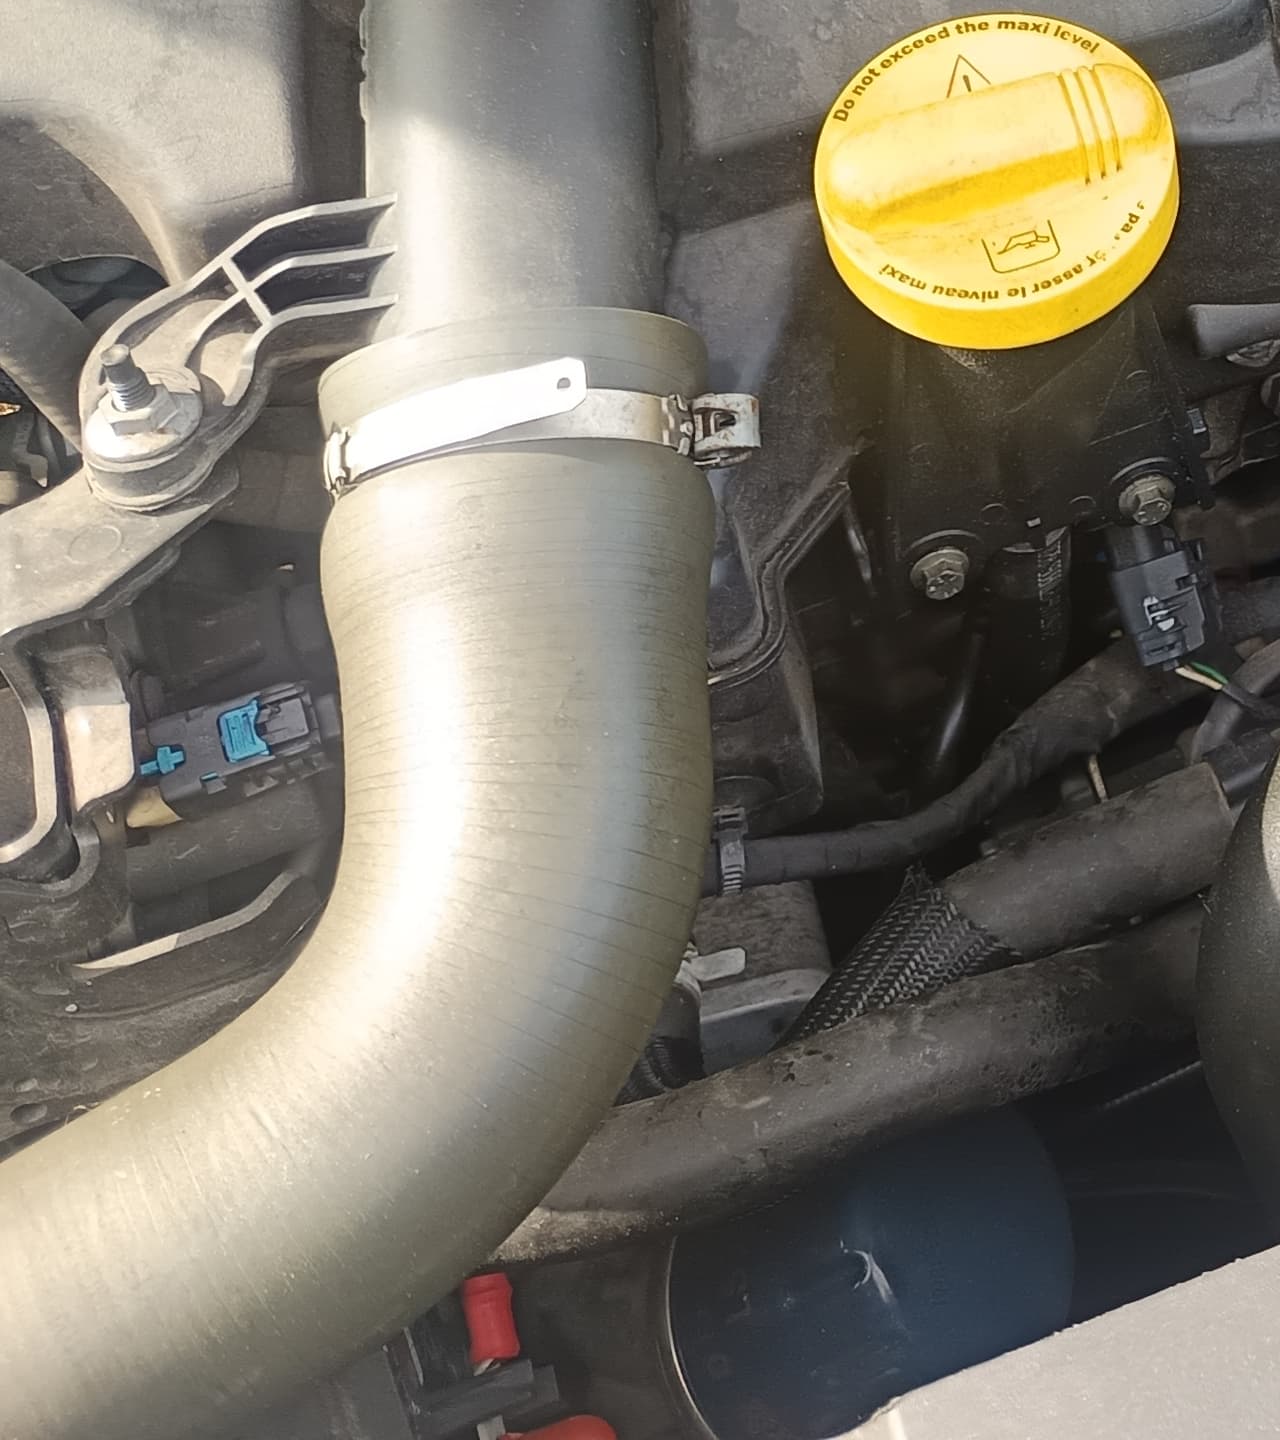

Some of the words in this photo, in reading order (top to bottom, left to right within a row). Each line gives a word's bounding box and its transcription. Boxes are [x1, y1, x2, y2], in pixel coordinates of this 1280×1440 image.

[833, 98, 856, 122] Do
[854, 68, 880, 101] not
[880, 26, 950, 69] exceed
[955, 19, 990, 35] the
[997, 19, 1050, 35] maxi
[1054, 24, 1101, 55] level
[878, 262, 927, 291] maxi
[932, 283, 1000, 301] niveau
[1007, 287, 1027, 299] le
